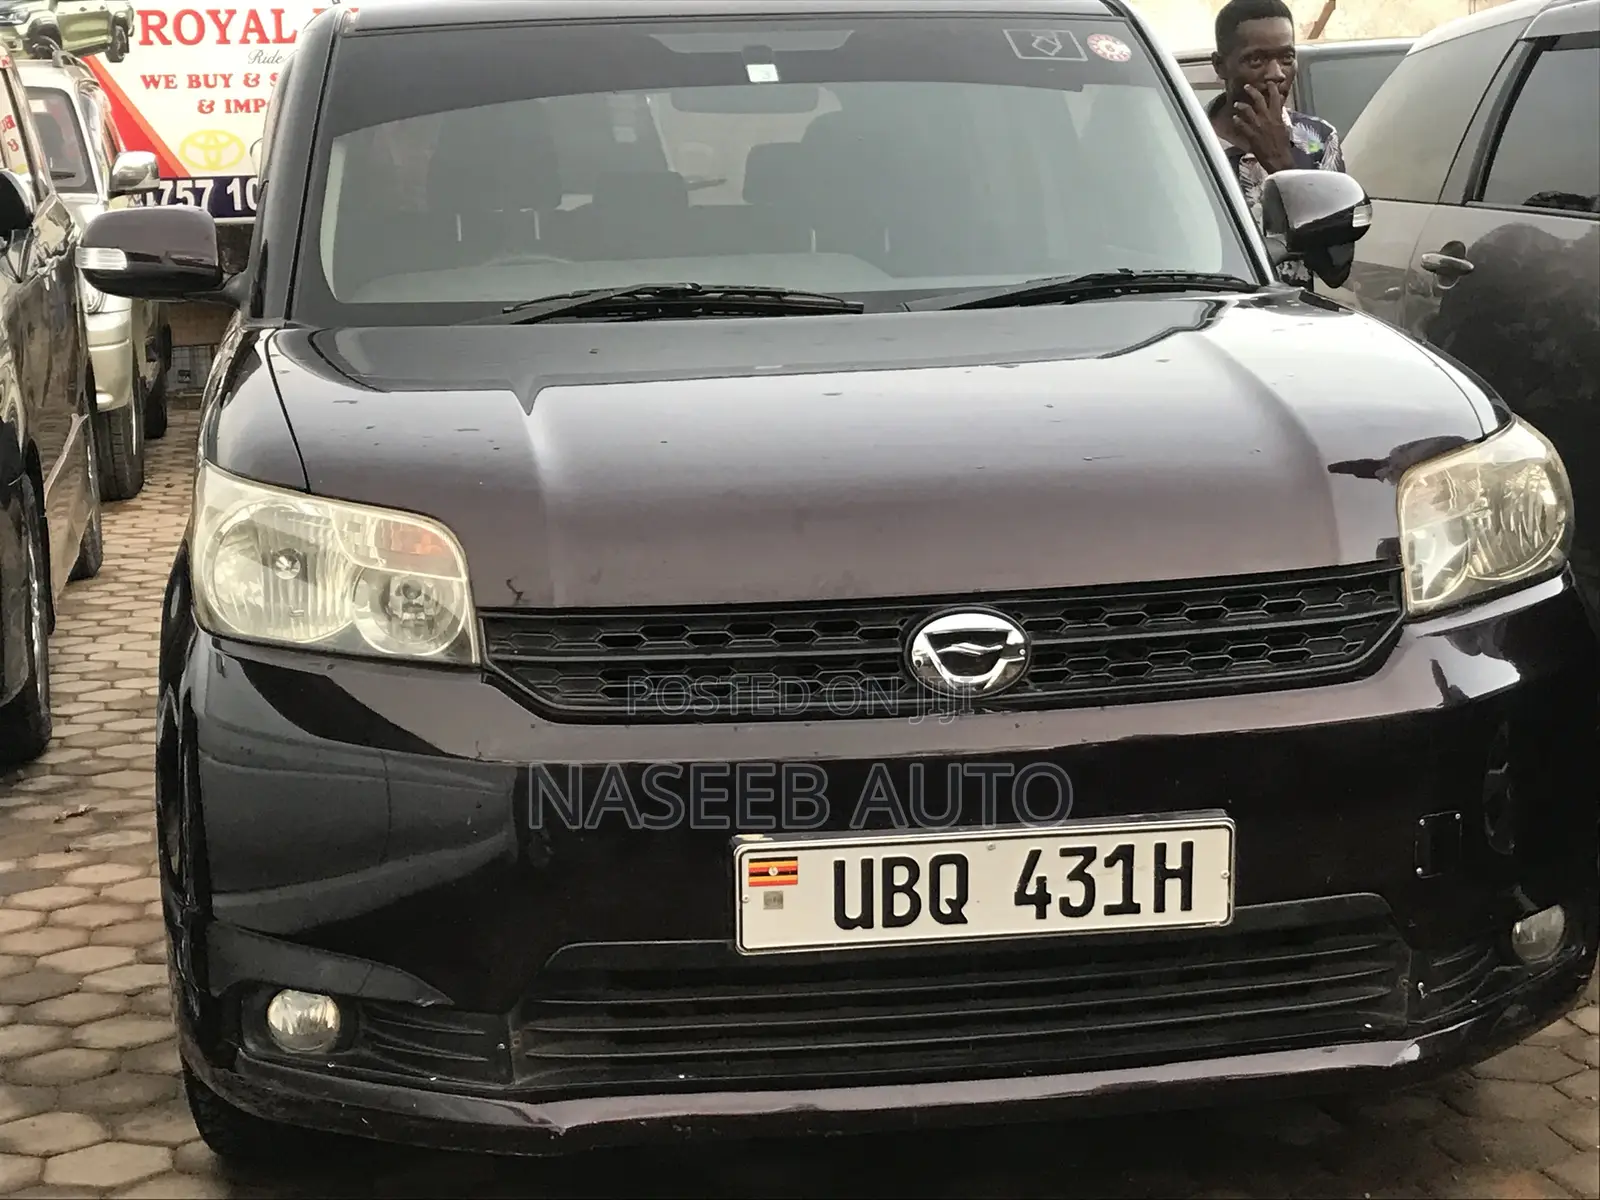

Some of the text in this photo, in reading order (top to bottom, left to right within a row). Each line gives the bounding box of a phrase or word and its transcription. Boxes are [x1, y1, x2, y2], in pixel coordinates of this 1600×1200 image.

[136, 8, 298, 46] ROYAL
[247, 49, 284, 65] Ride
[140, 74, 178, 90] WE
[186, 73, 234, 89] BUY
[242, 72, 261, 89] &
[196, 97, 272, 115] & IMP
[832, 840, 1195, 932] UBQ 431H
